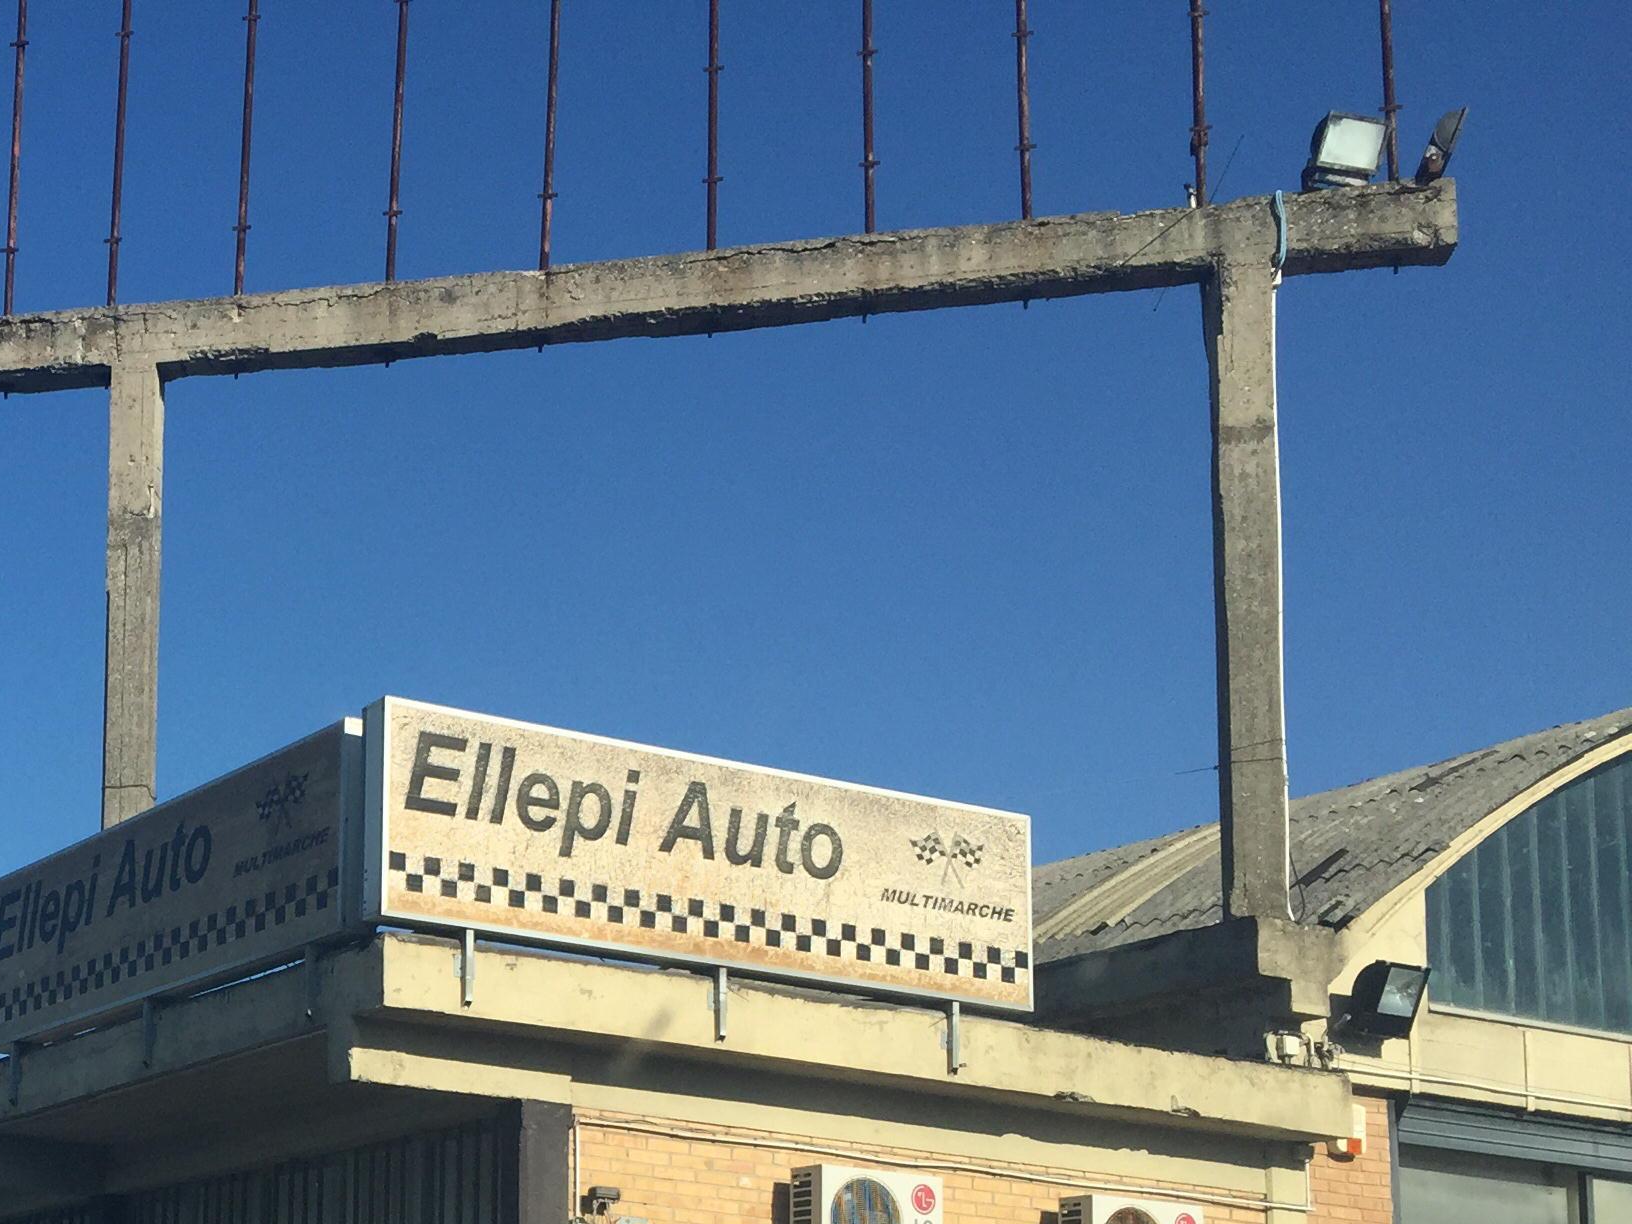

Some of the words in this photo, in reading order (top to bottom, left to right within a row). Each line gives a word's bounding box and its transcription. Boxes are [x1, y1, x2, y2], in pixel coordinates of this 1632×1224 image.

[404, 731, 640, 857] Ellepi
[658, 781, 843, 880] Auto
[106, 820, 212, 918] Auto
[232, 826, 331, 878] MULTIMARCHE
[880, 888, 1016, 923] MULTIMARCHE
